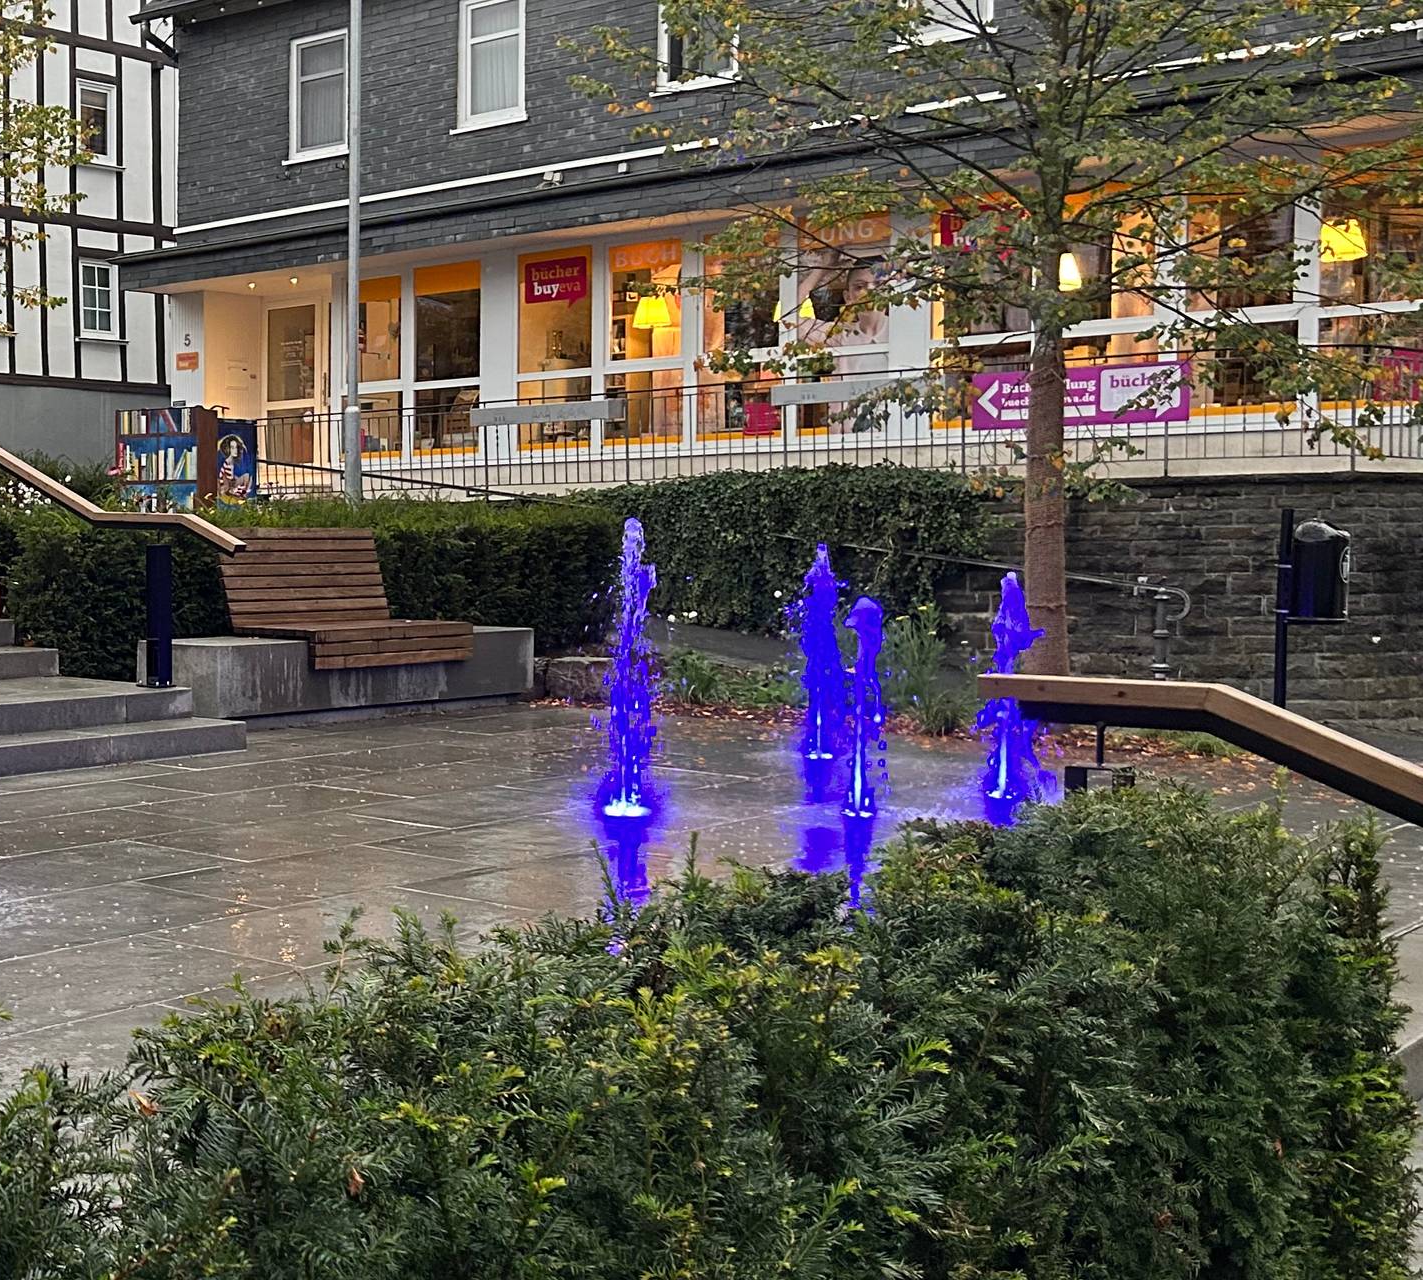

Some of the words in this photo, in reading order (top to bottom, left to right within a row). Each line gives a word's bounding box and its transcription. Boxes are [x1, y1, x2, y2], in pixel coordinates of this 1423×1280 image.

[531, 264, 580, 282] bücher
[533, 281, 581, 298] buyeva
[184, 334, 191, 347] 5
